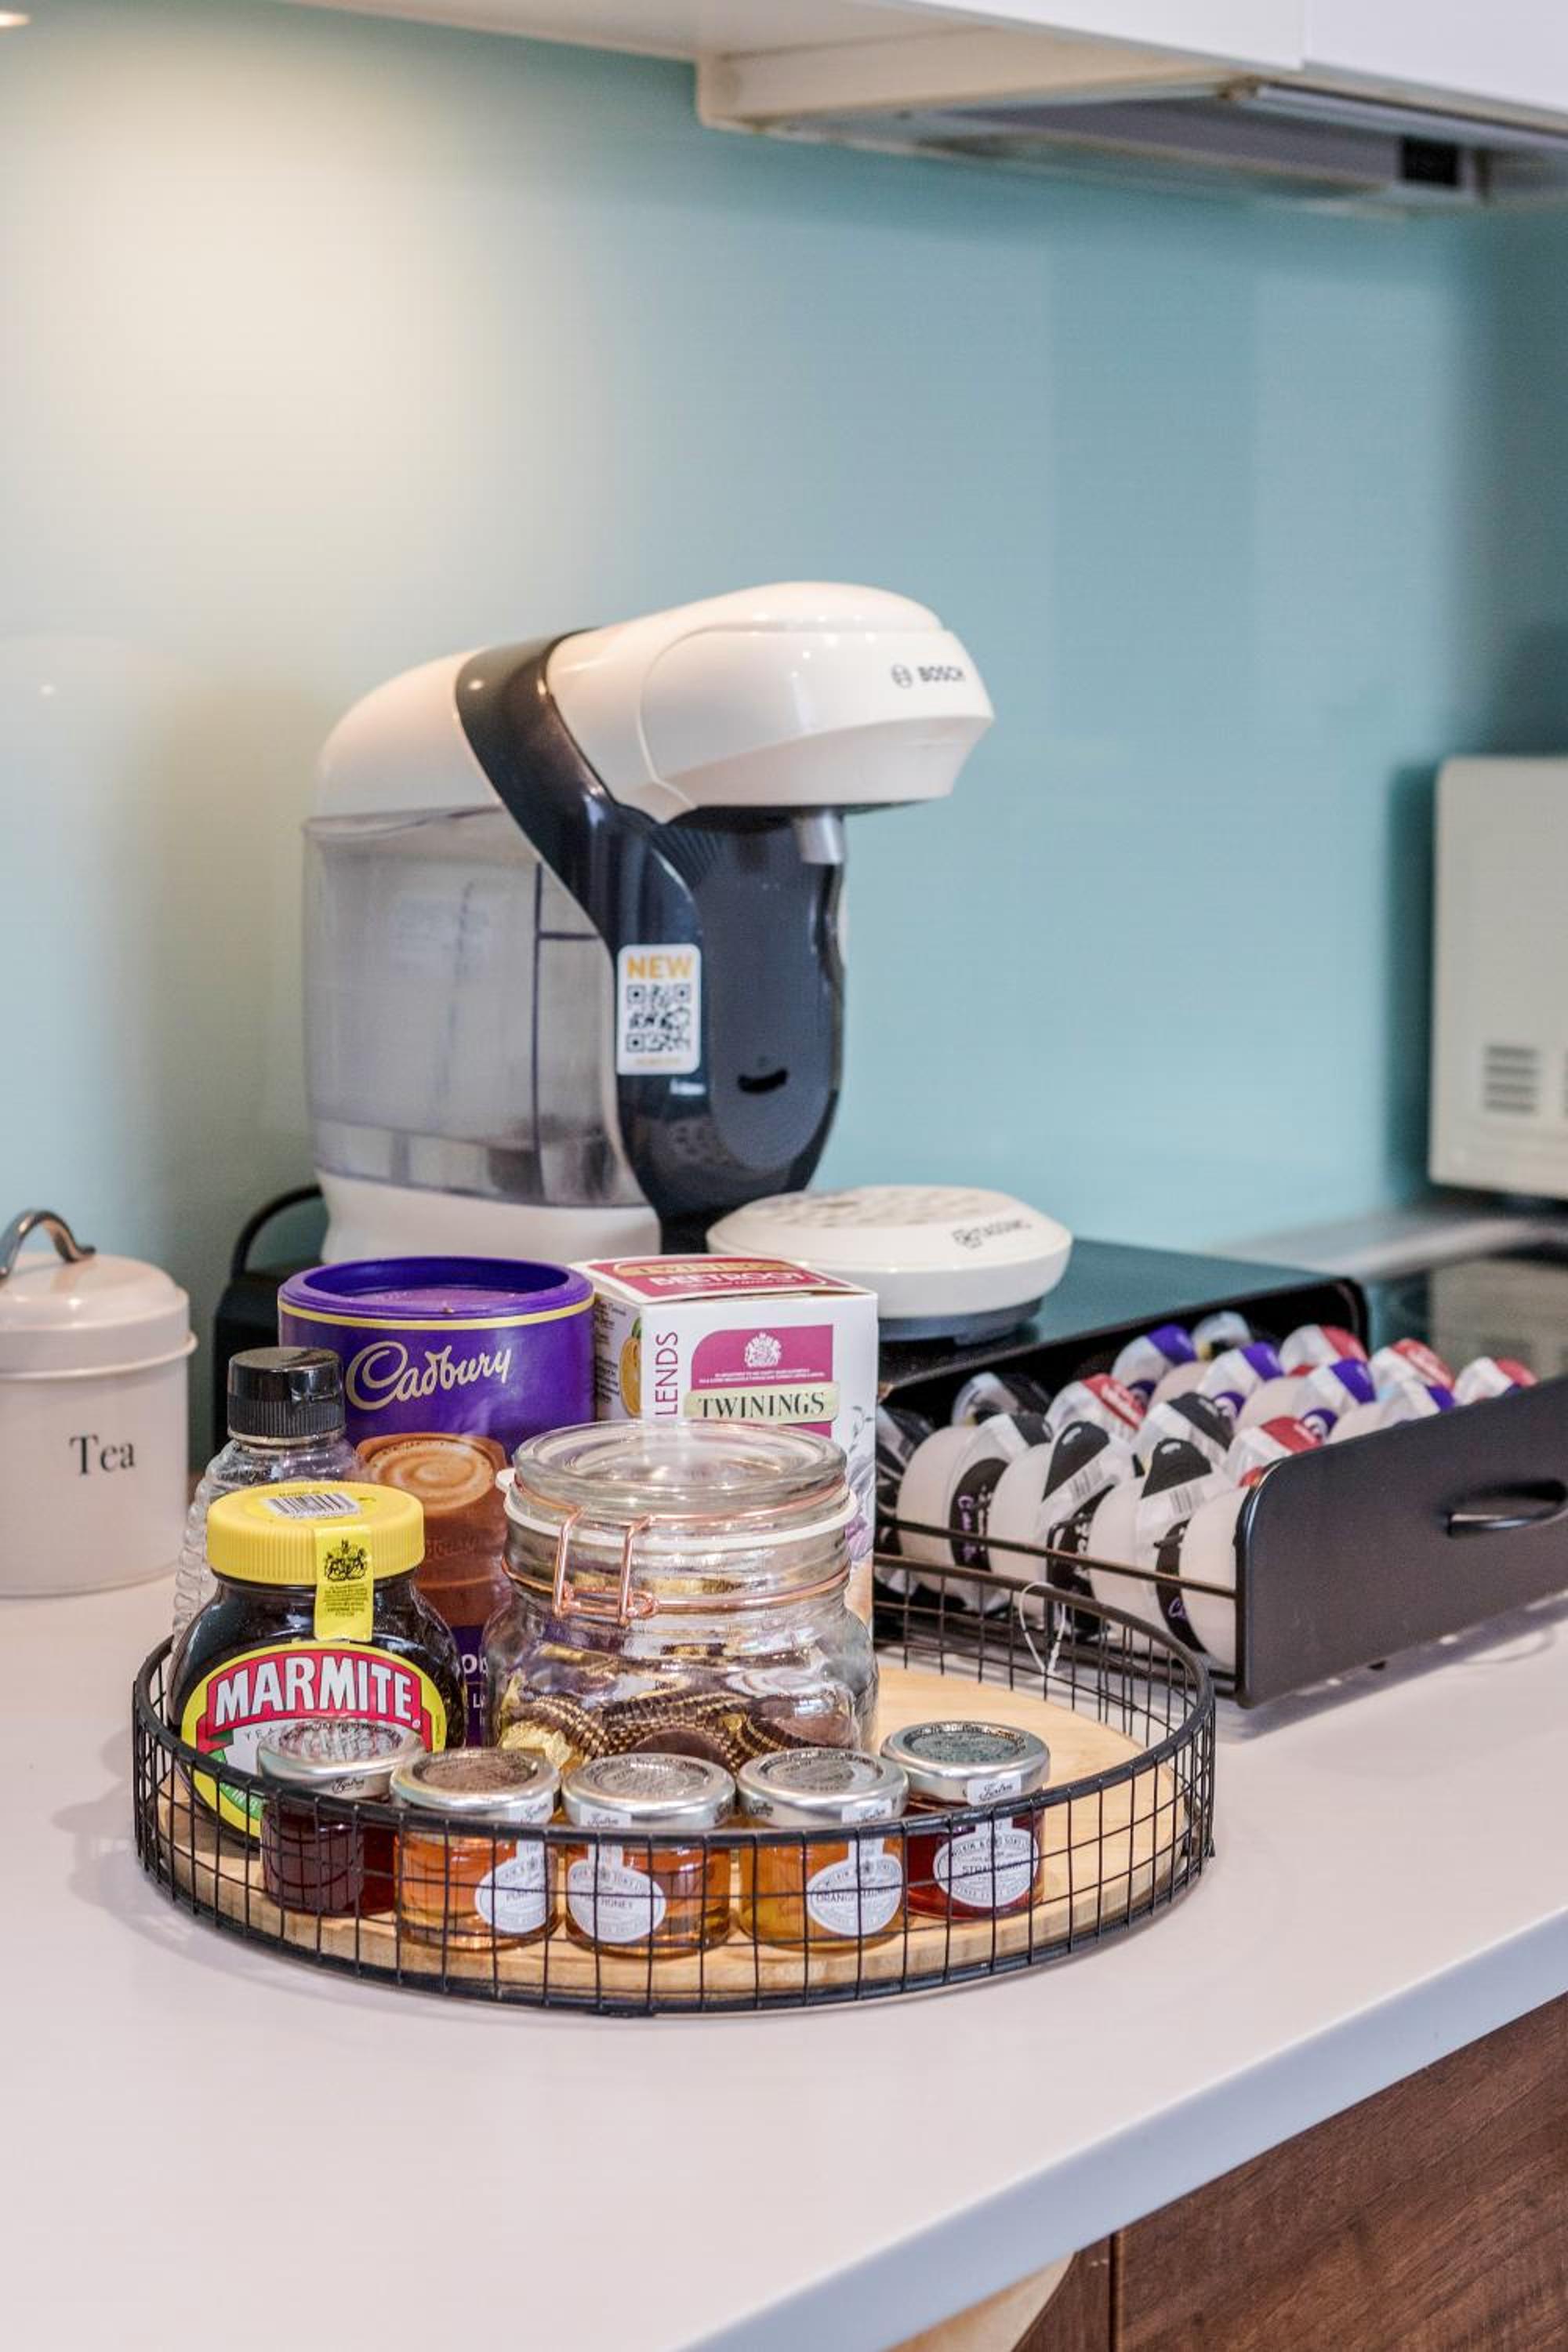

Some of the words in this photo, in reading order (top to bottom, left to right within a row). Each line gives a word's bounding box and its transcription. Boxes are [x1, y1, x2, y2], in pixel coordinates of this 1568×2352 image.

[918, 666, 965, 682] BOSCH
[628, 954, 692, 978] NEW
[346, 1341, 512, 1410] Cadbury
[698, 1392, 825, 1418] TWININGS
[69, 1434, 135, 1475] Tea
[215, 1656, 413, 1726] MARMITE
